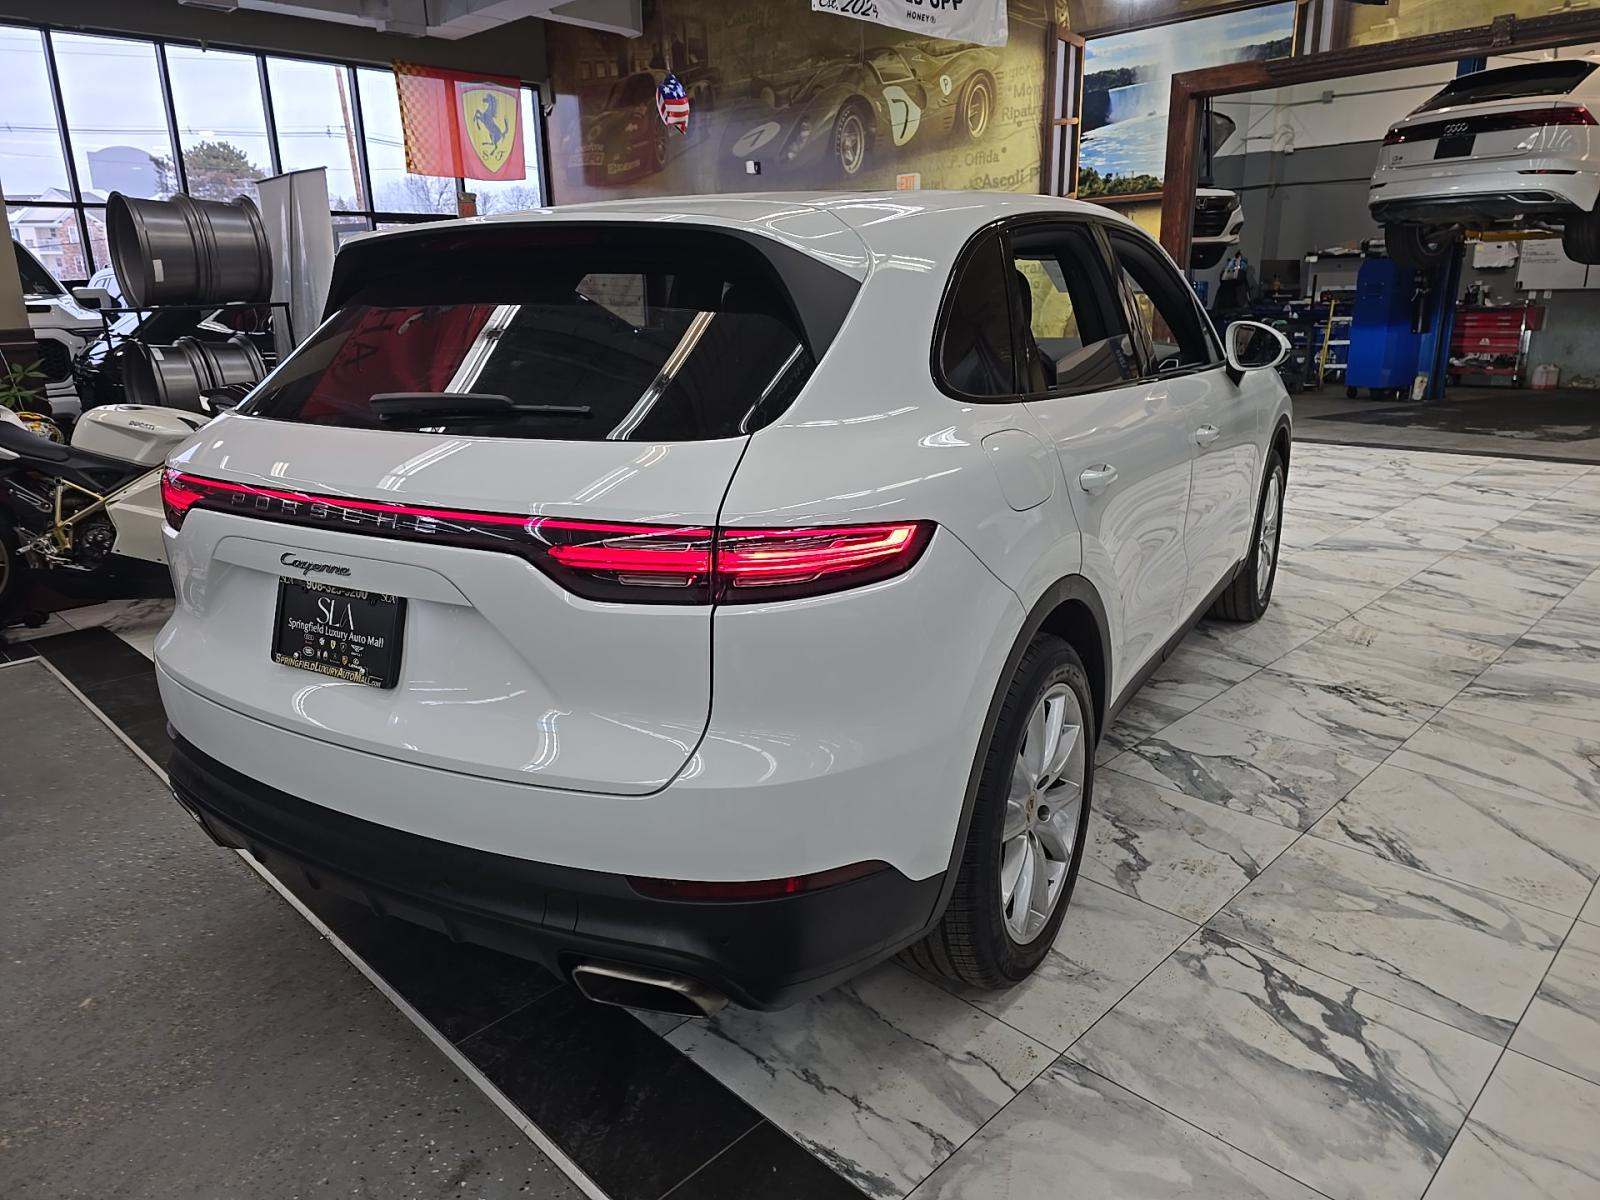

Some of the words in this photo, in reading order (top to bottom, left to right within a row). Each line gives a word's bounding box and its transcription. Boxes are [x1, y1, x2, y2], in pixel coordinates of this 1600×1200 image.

[841, 0, 878, 19] 2024
[891, 98, 909, 139] 7
[964, 150, 1000, 166] Offida
[128, 420, 155, 431] DUCATI
[231, 492, 436, 534] PORSCHE
[280, 552, 352, 576] Cayenne
[316, 596, 354, 631] SLA
[287, 617, 325, 635] Springfield
[325, 626, 348, 642] Luxury
[348, 631, 366, 644] Auto
[367, 635, 384, 648] Mall
